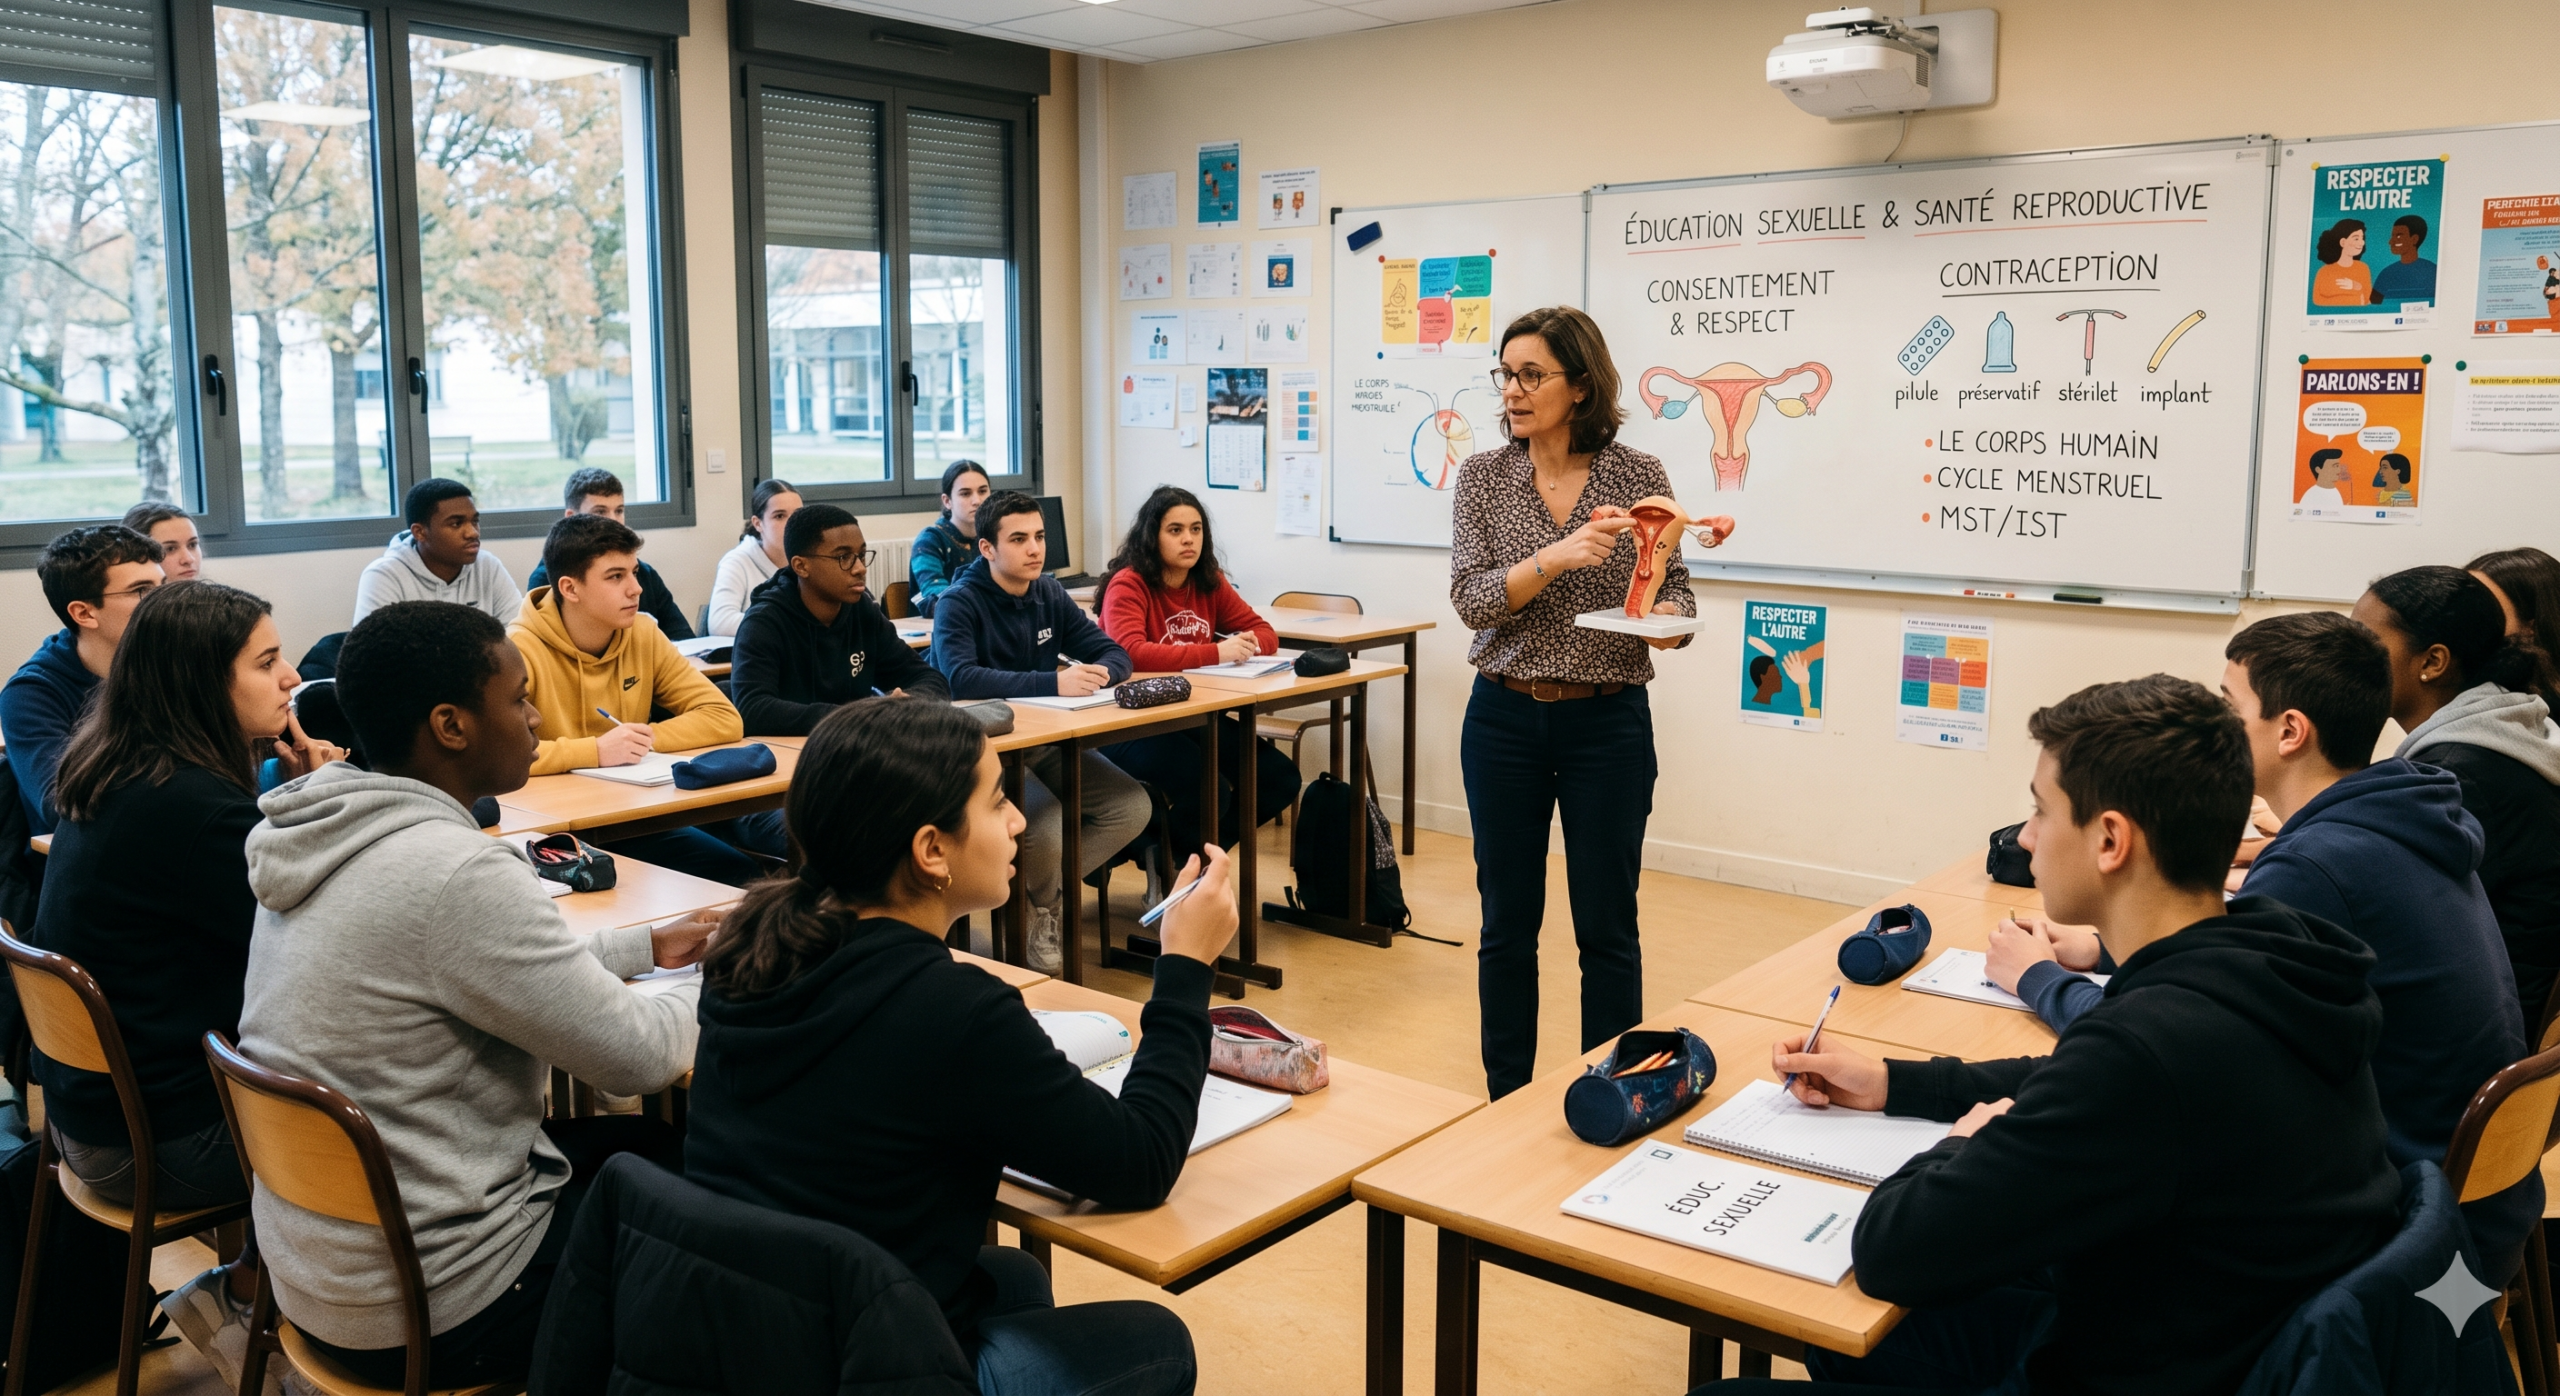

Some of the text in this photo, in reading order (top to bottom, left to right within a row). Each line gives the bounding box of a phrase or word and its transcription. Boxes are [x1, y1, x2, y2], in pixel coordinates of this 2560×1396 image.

[2327, 165, 2430, 190] RESPECTER
[1625, 180, 2211, 246] ÉDUCATION SEXUELLE & SANTÉ REPRODUCTIVE
[2340, 188, 2412, 211] L'AUTRE
[1939, 250, 2160, 287] CONTRACEPTION
[1647, 269, 1836, 304] CONSENTEMENT
[1670, 308, 1796, 336] & RESPECT
[1355, 379, 1364, 388] LE
[1365, 379, 1390, 388] CORPS
[1895, 379, 2213, 410] pilule préservatif stérilet implant
[2306, 371, 2420, 391] PARLONS-EN !
[1939, 429, 2158, 460] LE CORPS HUMAIN
[1937, 466, 2163, 500] CYCLE MENSTRUEL
[1940, 504, 2068, 539] MST/IST
[1752, 605, 1817, 625] RESPECTER
[1762, 622, 1807, 640] L'AUTRE
[1664, 1180, 1726, 1216] ÉDUC.
[1702, 1180, 1782, 1236] SEXUELLE
